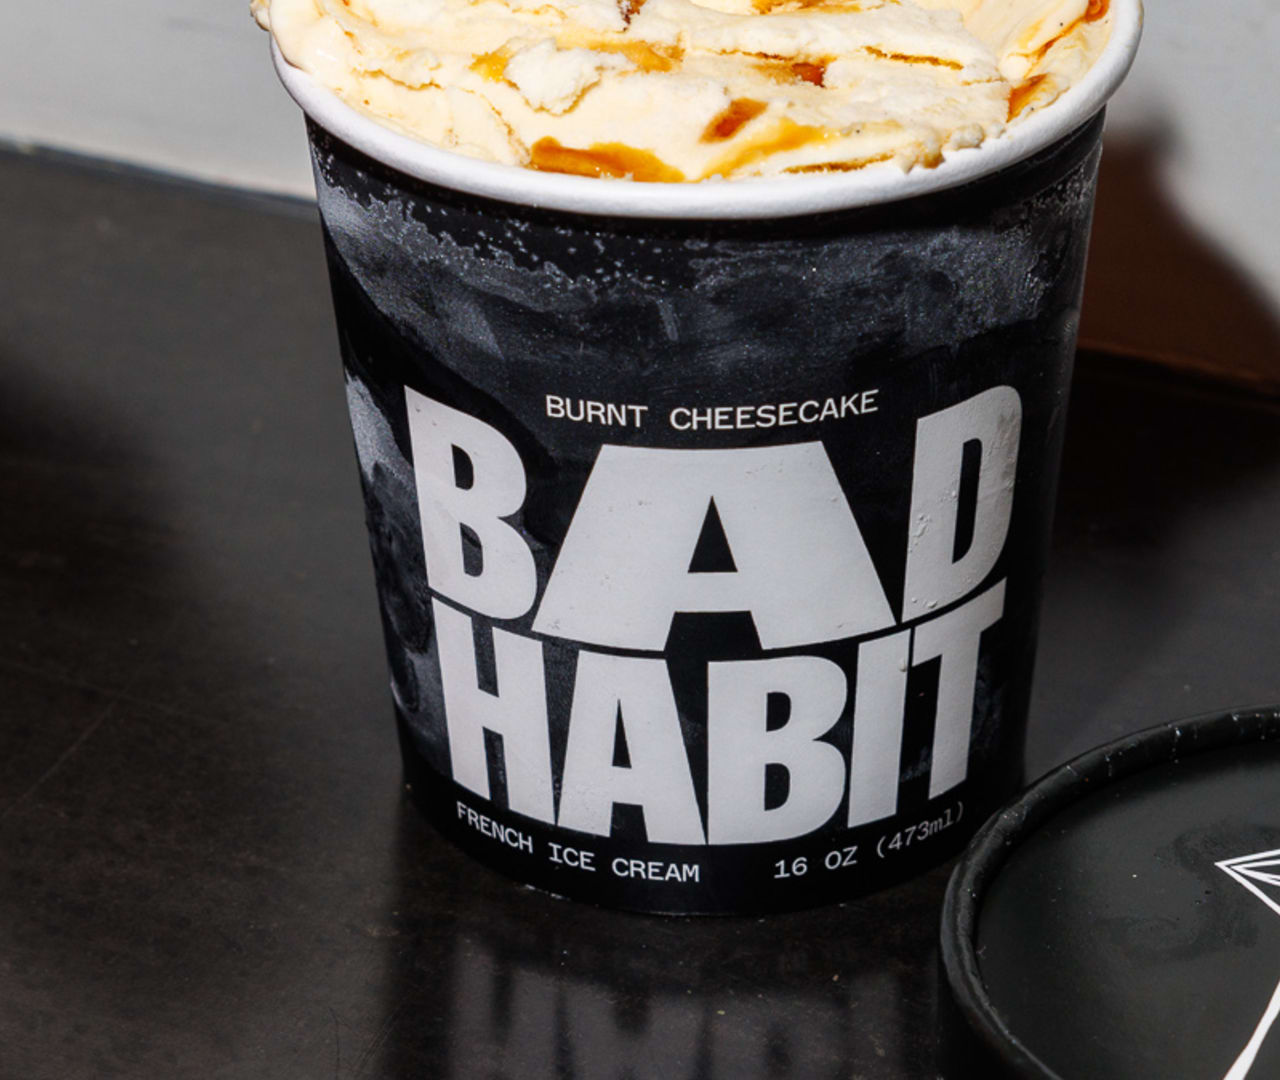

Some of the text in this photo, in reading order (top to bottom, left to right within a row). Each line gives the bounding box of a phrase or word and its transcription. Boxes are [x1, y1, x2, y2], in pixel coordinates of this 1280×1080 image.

[545, 389, 879, 431] BURNT CHEESECAKE
[403, 384, 1023, 652] BAD
[431, 577, 1007, 846] HABIT
[457, 802, 700, 883] FRENCH ICE CREAM
[774, 801, 964, 879] 16 OZ (473ml)
